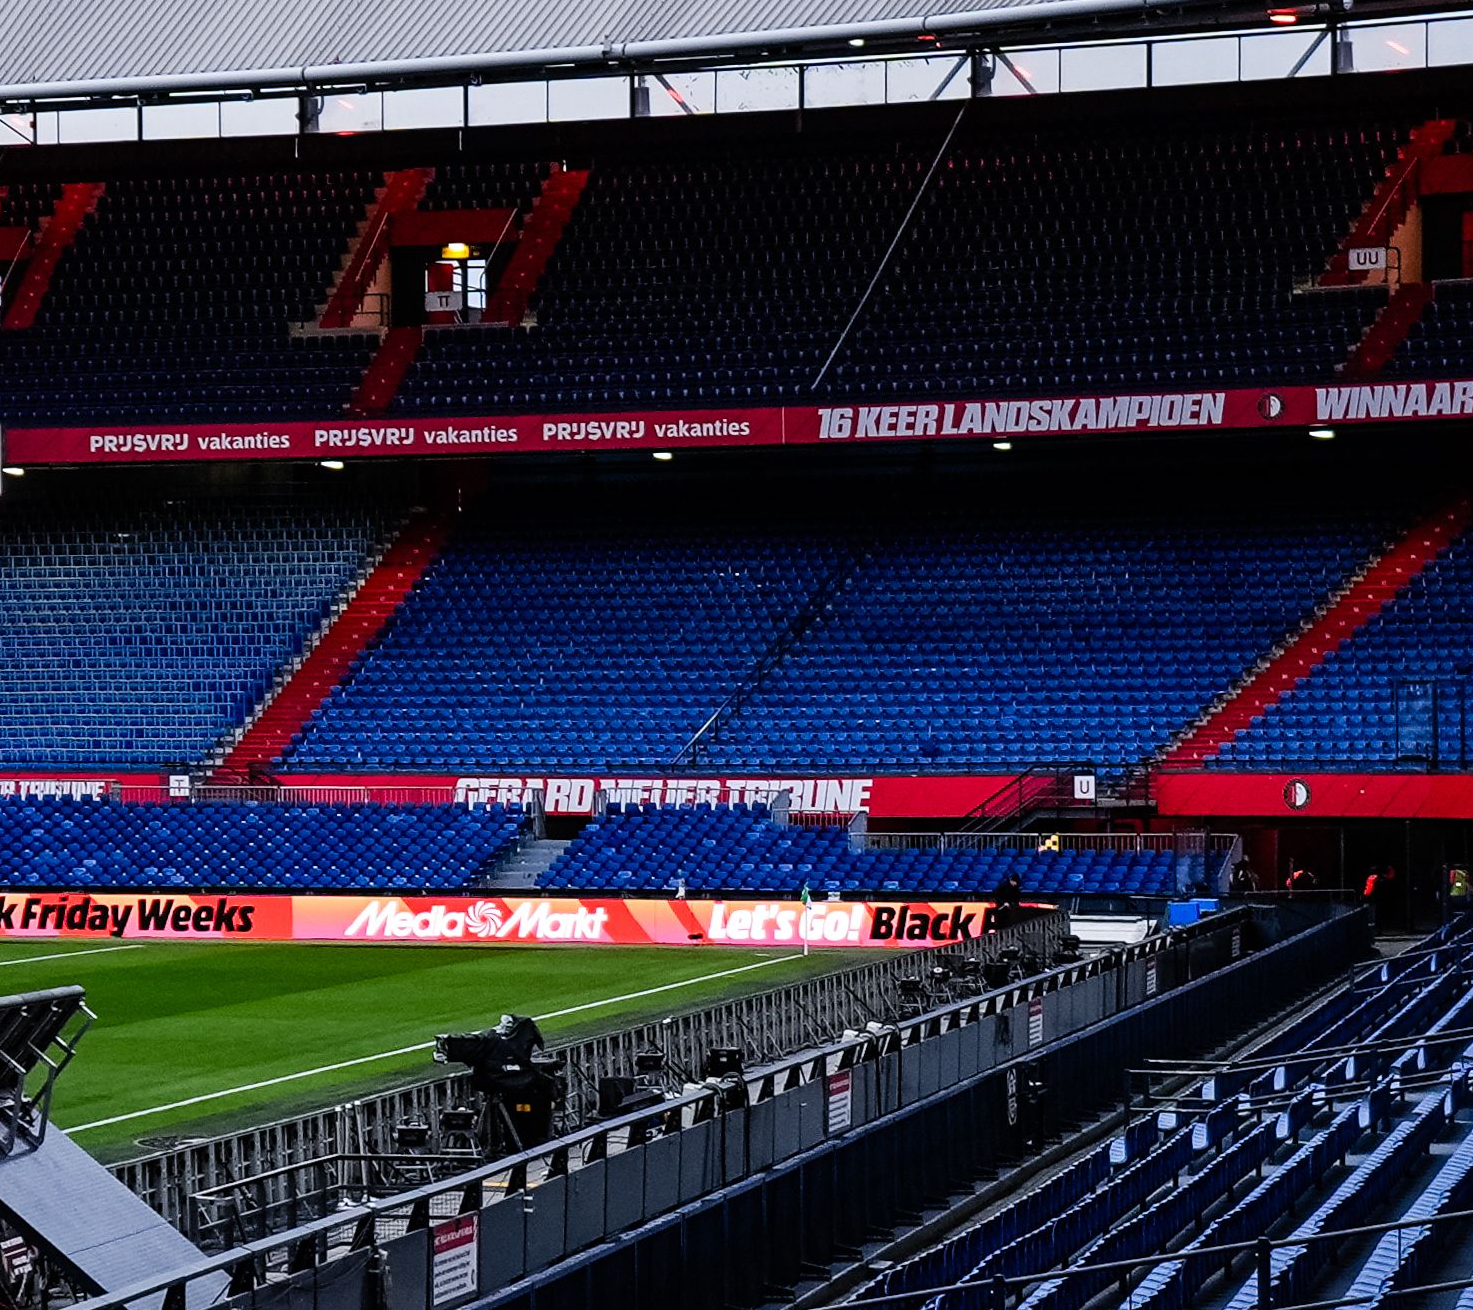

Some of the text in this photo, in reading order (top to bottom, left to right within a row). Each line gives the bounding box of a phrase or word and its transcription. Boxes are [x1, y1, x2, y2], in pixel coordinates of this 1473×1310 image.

[1357, 252, 1378, 265] UU
[654, 418, 751, 439] vakanties
[817, 393, 1227, 438] 16 KEER LANDSKAMPIOEN
[198, 432, 291, 453] vakanties
[423, 425, 518, 445] vakanties
[454, 778, 595, 813] GERARD
[726, 778, 874, 814] TRIBUNE
[1079, 780, 1090, 795] U
[21, 895, 135, 938] Friday
[139, 897, 255, 932] Weeks
[345, 897, 609, 939] MediaMarkt
[708, 899, 796, 940] Let's
[870, 903, 978, 942] Black
